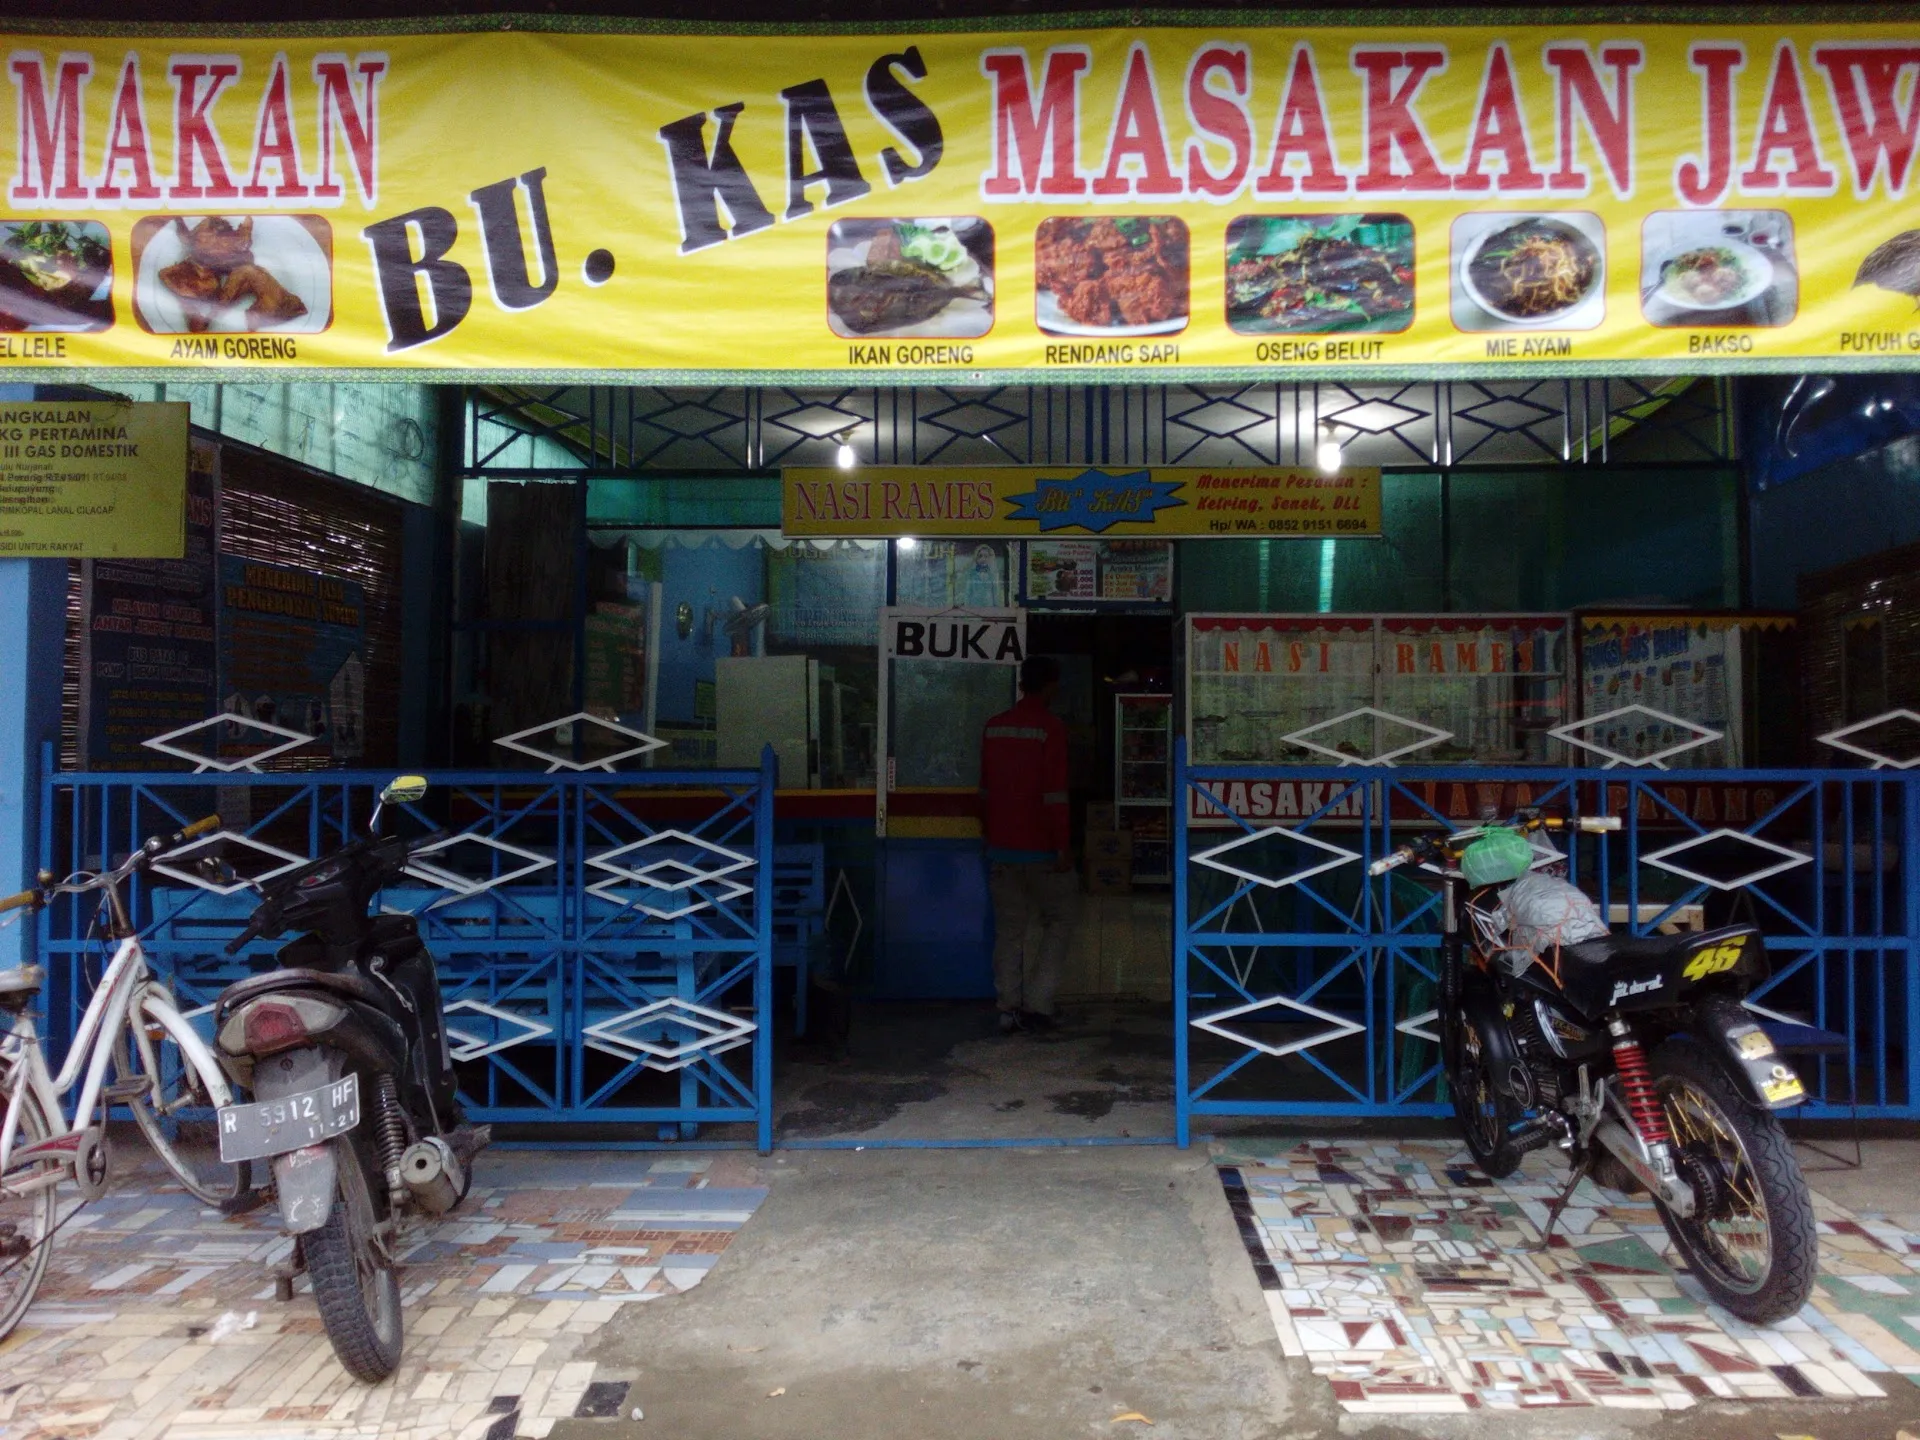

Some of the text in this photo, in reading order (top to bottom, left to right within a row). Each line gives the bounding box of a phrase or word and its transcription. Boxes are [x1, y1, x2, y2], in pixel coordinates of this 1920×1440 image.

[10, 53, 388, 207] MAKAN
[983, 41, 1920, 205] MASAKAN JAW
[363, 46, 944, 353] BU. KAS
[23, 337, 66, 358] LELE
[170, 337, 297, 360] AYAM GORENG
[1257, 342, 1385, 362] OSENG BELUT
[1486, 338, 1572, 358] MIE AYAM
[1689, 335, 1753, 354] BAKSO
[1841, 333, 1902, 352] PUYUH
[849, 346, 974, 365] IKAN GORENG
[1046, 345, 1180, 364] RENDANG SAPI
[30, 427, 128, 441] PERTAMINA
[4, 444, 139, 458] III GAS DOMESTIK
[1196, 474, 1281, 489] Menerima
[46, 506, 74, 515] LANAL
[77, 505, 115, 515] CILACAP
[794, 481, 995, 520] NASI RAMES
[1235, 519, 1257, 530] WA
[1268, 519, 1298, 531] 0852
[1302, 519, 1332, 531] 9151
[19, 542, 47, 551] UNTUK
[50, 542, 84, 551] RAKYAT
[894, 621, 1025, 661] BUKA
[1224, 639, 1535, 674] NASI RAMES
[1195, 781, 1375, 816] MASAKAN
[1682, 935, 1748, 982] 46
[224, 1112, 238, 1134] R
[332, 1080, 354, 1109] HF
